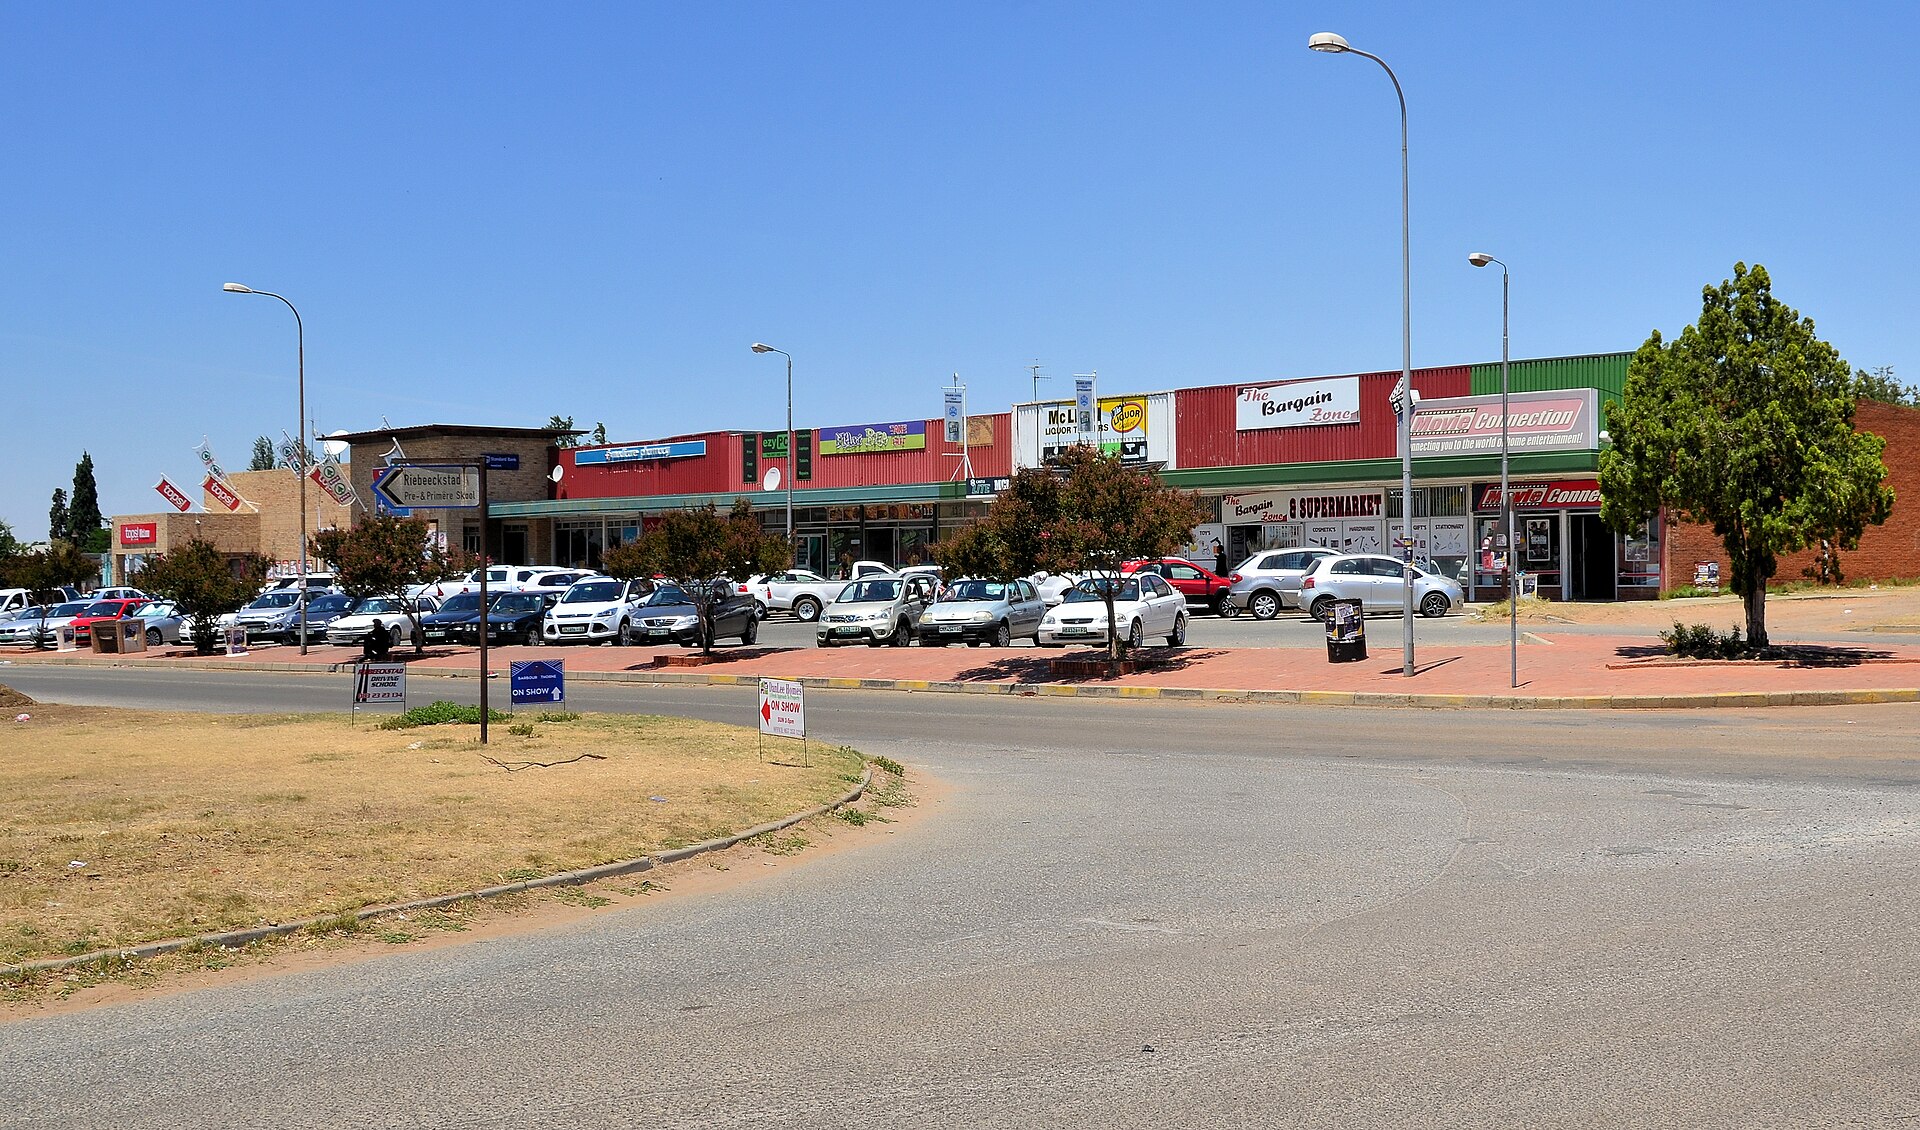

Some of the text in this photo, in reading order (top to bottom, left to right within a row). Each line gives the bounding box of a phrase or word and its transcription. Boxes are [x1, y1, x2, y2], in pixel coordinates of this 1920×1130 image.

[1244, 389, 1269, 402] The
[1262, 390, 1333, 416] Bargain
[1113, 409, 1140, 426] LIQUOR
[1309, 407, 1350, 422] Zone
[1412, 409, 1574, 432] Movie Connection
[1045, 426, 1072, 436] LIQUOR
[1411, 440, 1440, 451] nnecting
[1440, 441, 1454, 451] you
[1454, 439, 1462, 450] to
[1462, 438, 1475, 449] the
[1475, 436, 1497, 449] world
[1526, 432, 1583, 445] entertainment!
[403, 474, 461, 486] Riebeeckstad
[163, 484, 186, 509] tops!
[211, 482, 236, 507] tops!
[456, 490, 476, 500] Skool
[1225, 495, 1240, 506] The
[1486, 488, 1602, 503] Mvie Conne
[923, 507, 934, 516] 113
[1235, 499, 1274, 517] Bargain
[1289, 494, 1382, 519] & SUPERMARKET
[1261, 511, 1284, 523] Zone
[512, 687, 550, 697] ON SHOW
[770, 700, 801, 713] ON SHOW
